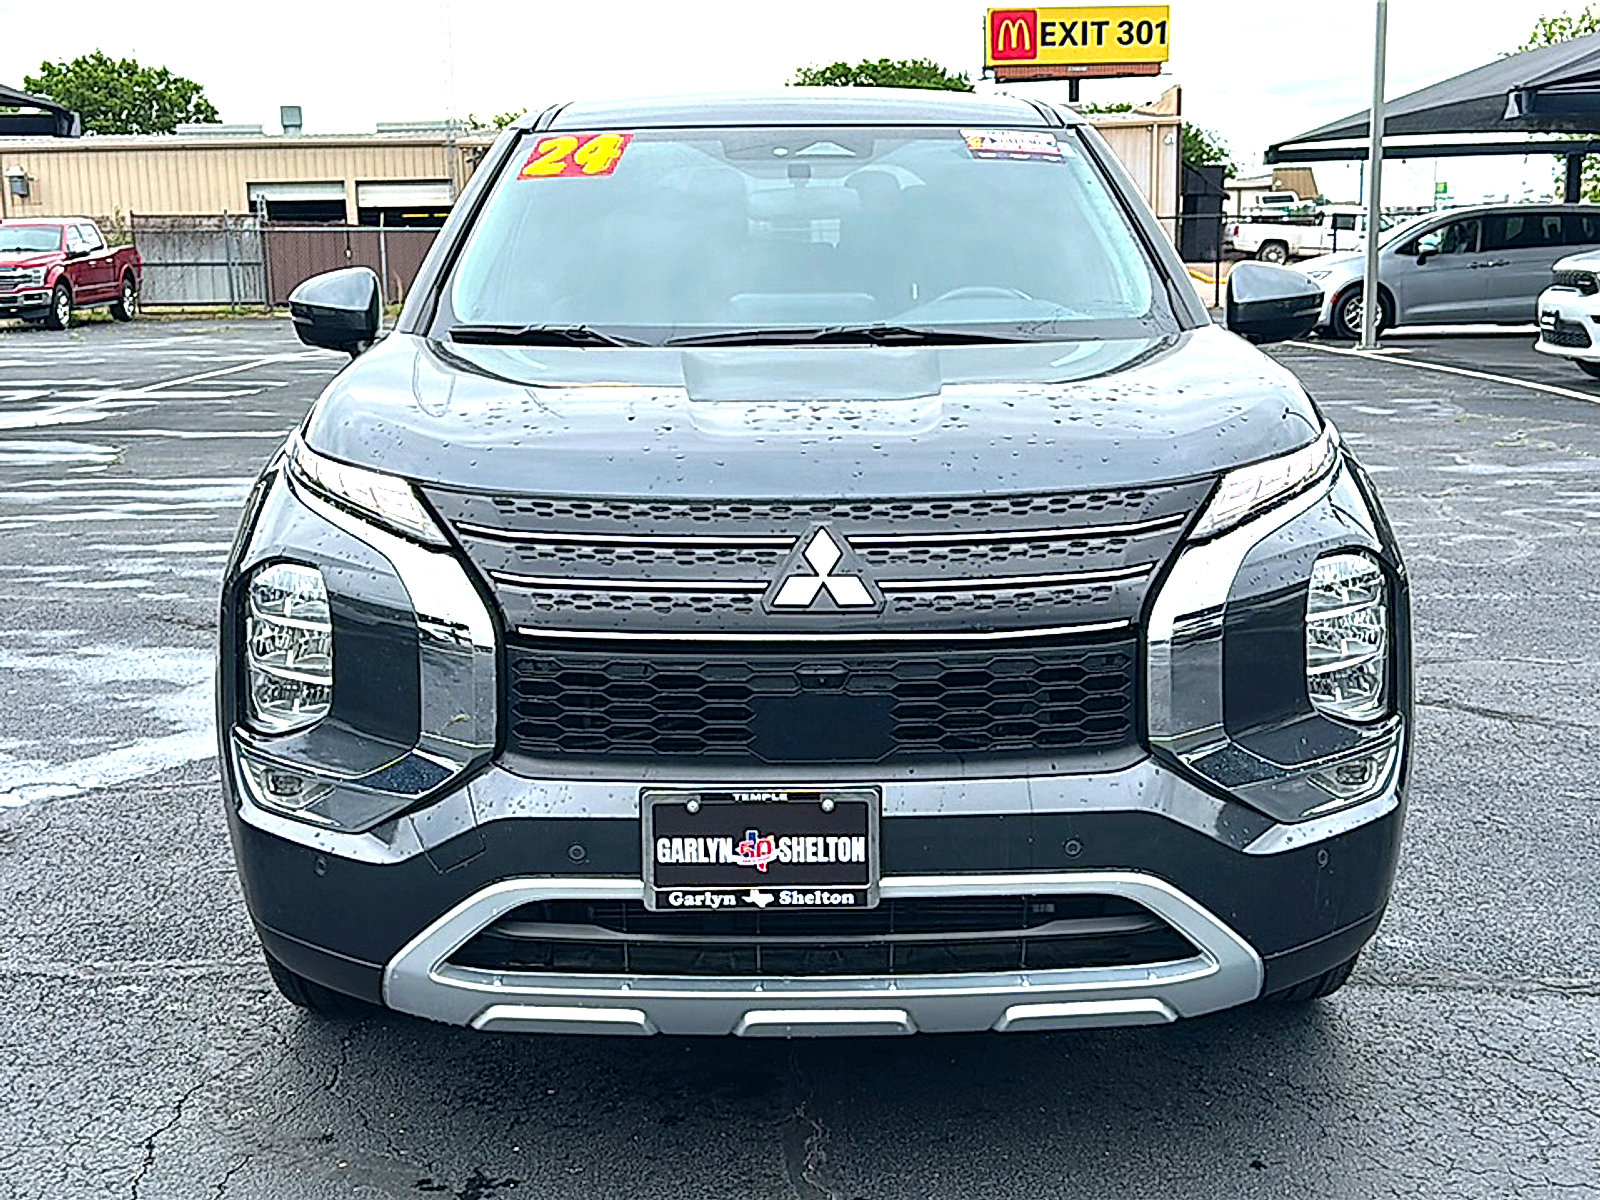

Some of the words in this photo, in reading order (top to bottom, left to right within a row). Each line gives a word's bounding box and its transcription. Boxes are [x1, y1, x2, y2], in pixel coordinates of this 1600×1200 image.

[1041, 21, 1110, 46] EXIT
[1117, 20, 1168, 45] 301
[522, 134, 624, 175] 24
[732, 793, 789, 802] TEMPLE
[657, 837, 734, 864] GARLYN
[779, 836, 866, 863] SHELTON
[668, 891, 737, 909] Garlyn
[779, 890, 855, 905] Shelton
